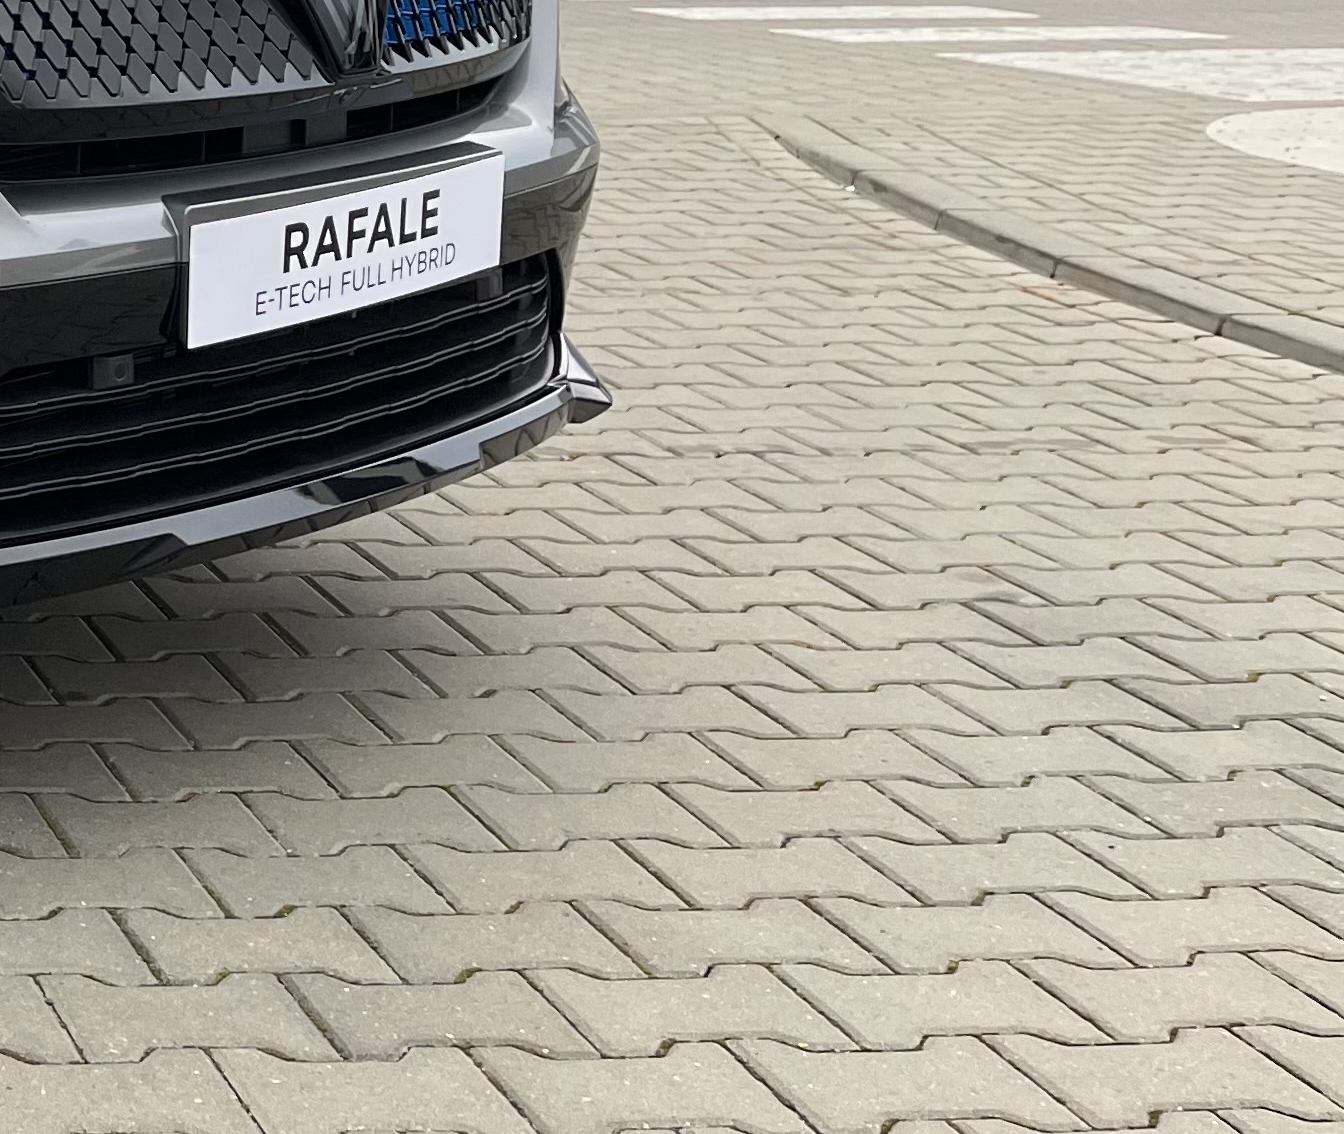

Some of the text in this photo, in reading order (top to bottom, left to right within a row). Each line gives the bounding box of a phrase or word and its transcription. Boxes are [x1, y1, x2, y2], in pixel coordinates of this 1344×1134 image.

[283, 189, 441, 273] RAFALE
[255, 243, 456, 315] E-TECH FULL HYBRID
